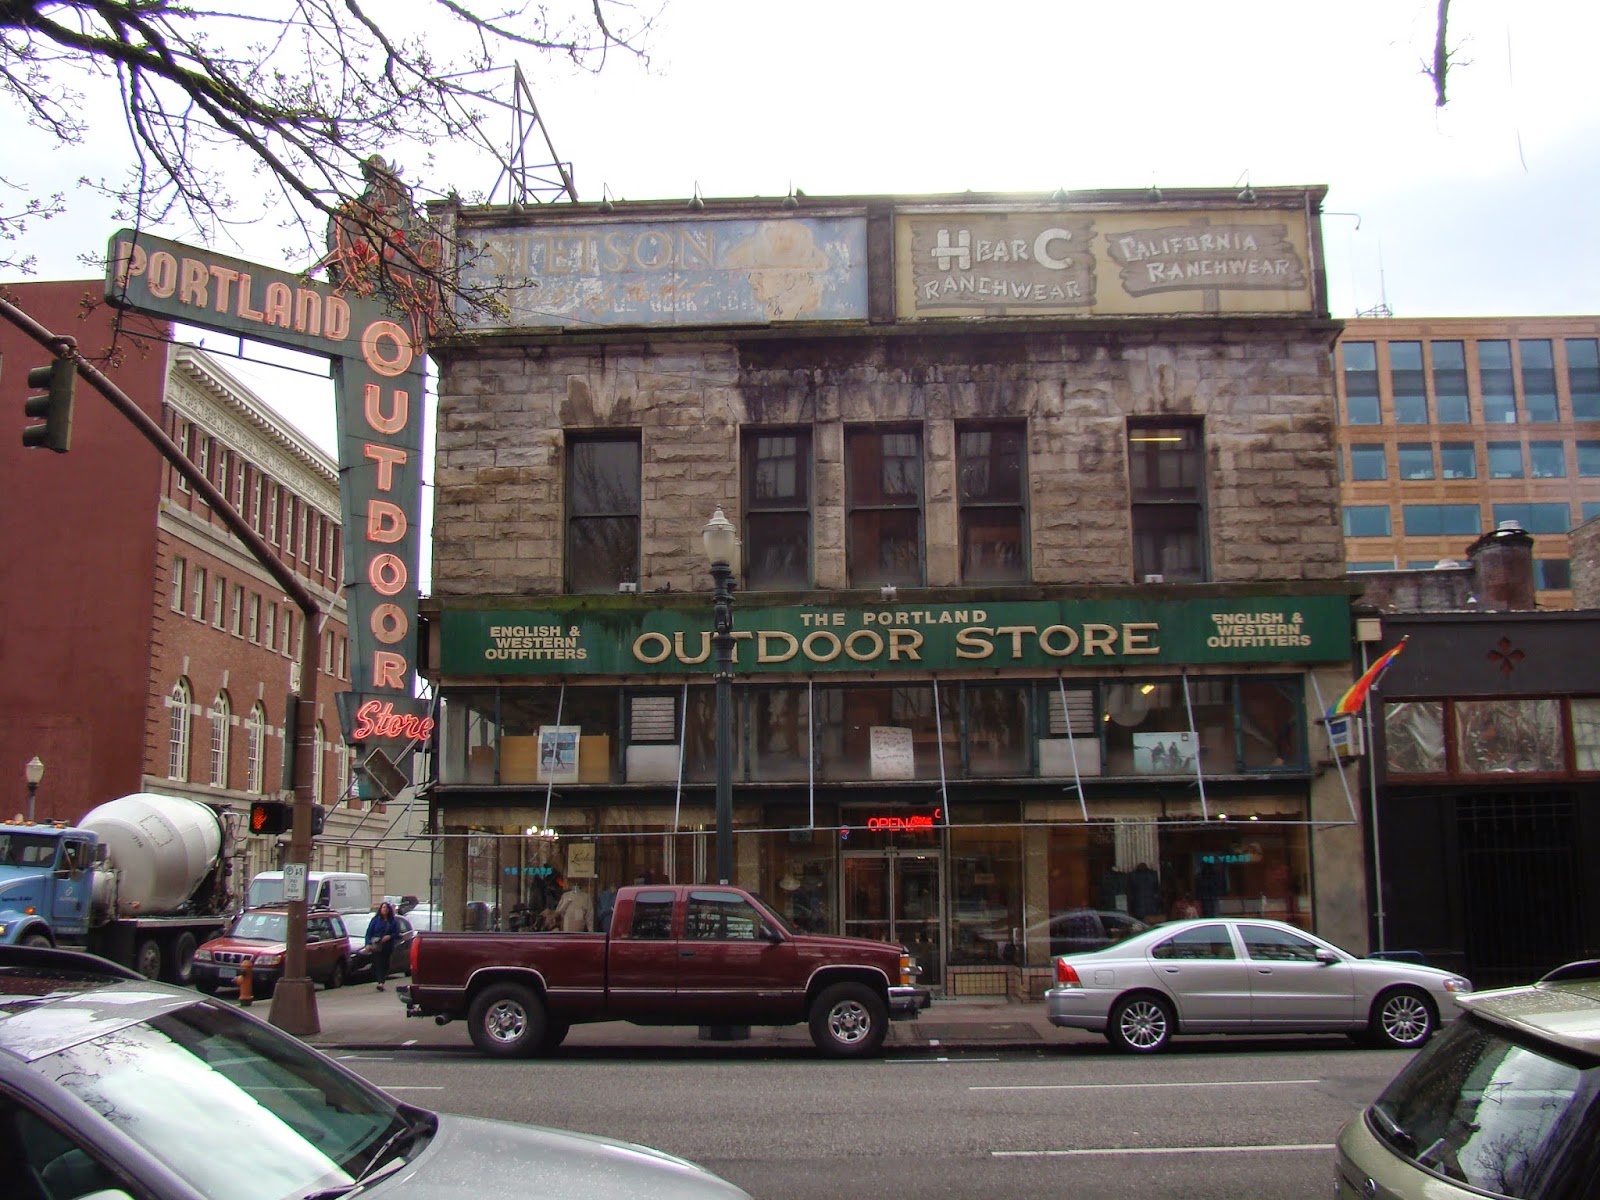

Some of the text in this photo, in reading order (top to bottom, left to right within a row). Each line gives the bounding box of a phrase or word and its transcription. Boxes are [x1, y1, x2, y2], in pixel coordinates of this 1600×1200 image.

[931, 228, 1072, 270] H BAR C
[1119, 233, 1258, 262] CALIFORNIA
[1146, 259, 1290, 283] RANCHWEAR
[116, 241, 350, 341] PORTLAND
[923, 274, 1081, 300] RANCHWEAR
[362, 321, 412, 690] OUTDOOR
[801, 609, 988, 626] THE PORTLAND
[1211, 613, 1303, 625] ENGLISH &
[490, 625, 580, 637] ENGLISH &
[1218, 624, 1300, 636] WESTERN
[495, 636, 577, 649] WESTERN
[632, 622, 1160, 665] OUTDOOR STORE
[1207, 634, 1311, 648] OUTFITTERS
[484, 648, 587, 660] OUTFITTERS
[353, 700, 435, 740] Store
[868, 817, 909, 832] OPEN
